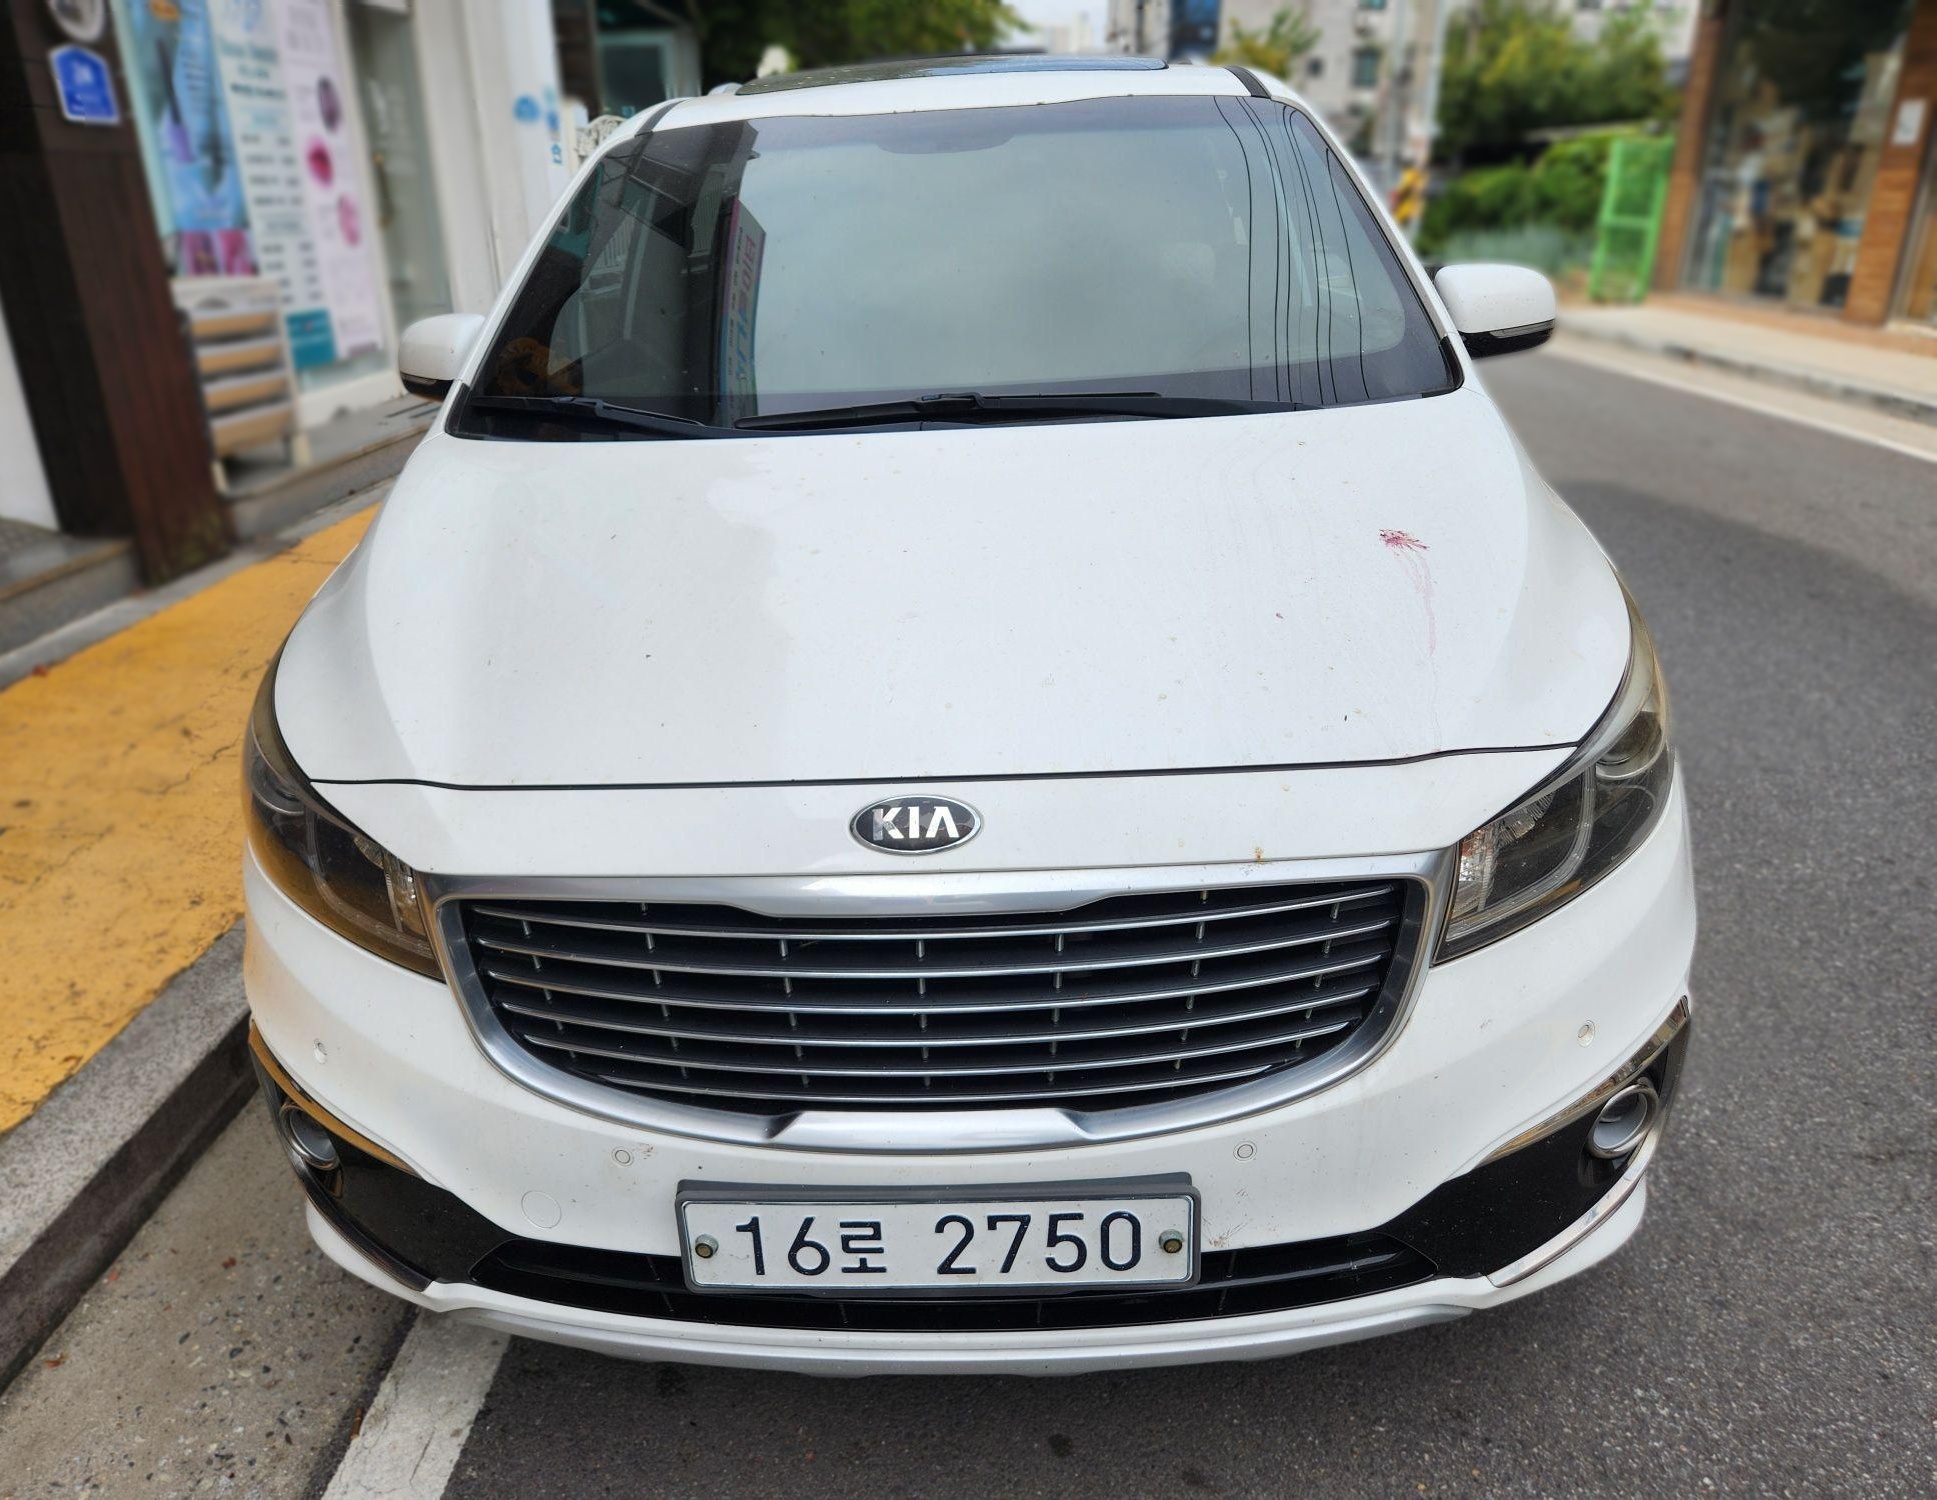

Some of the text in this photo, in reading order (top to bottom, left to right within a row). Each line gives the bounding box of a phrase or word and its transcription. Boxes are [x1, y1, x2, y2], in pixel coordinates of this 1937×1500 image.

[872, 806, 960, 841] KIA
[736, 1211, 1142, 1276] 16로 2750
